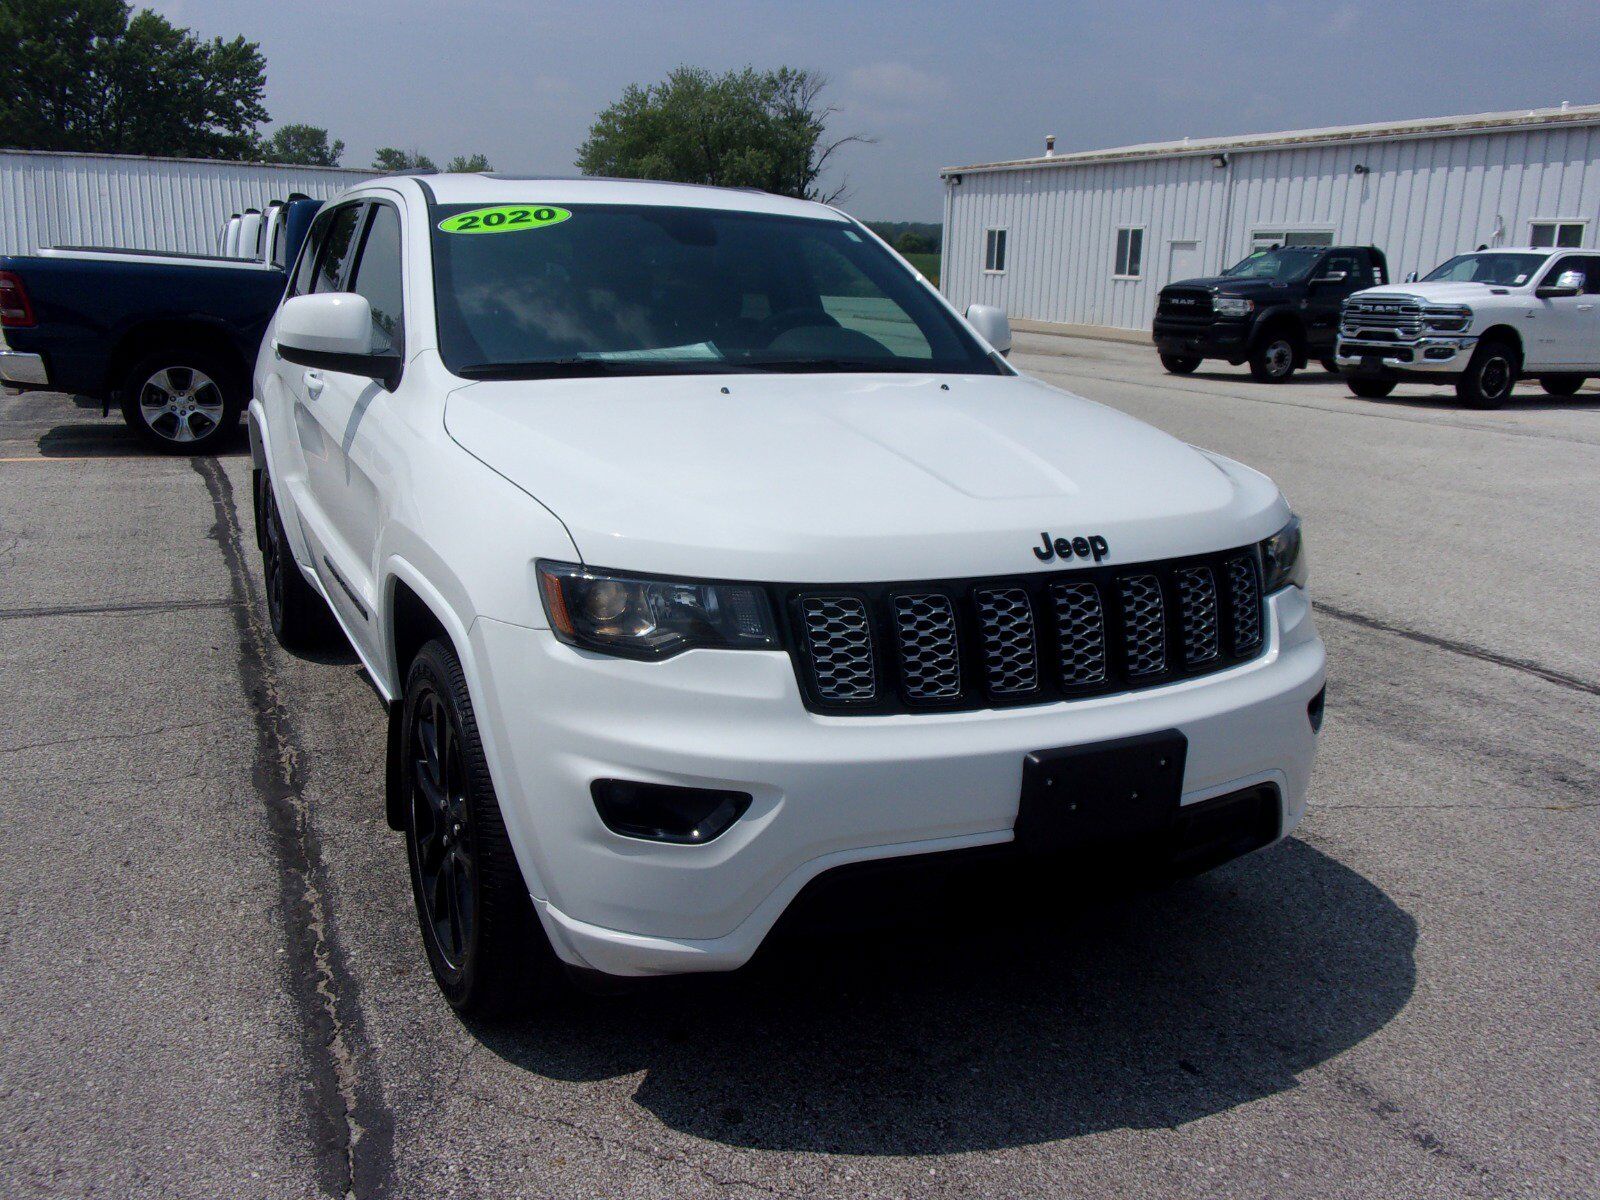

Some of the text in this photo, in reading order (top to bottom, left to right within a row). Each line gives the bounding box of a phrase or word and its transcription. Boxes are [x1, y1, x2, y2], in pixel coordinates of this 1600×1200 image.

[456, 208, 556, 231] 2020
[1360, 304, 1399, 313] RAM
[1032, 531, 1109, 562] Jeep
